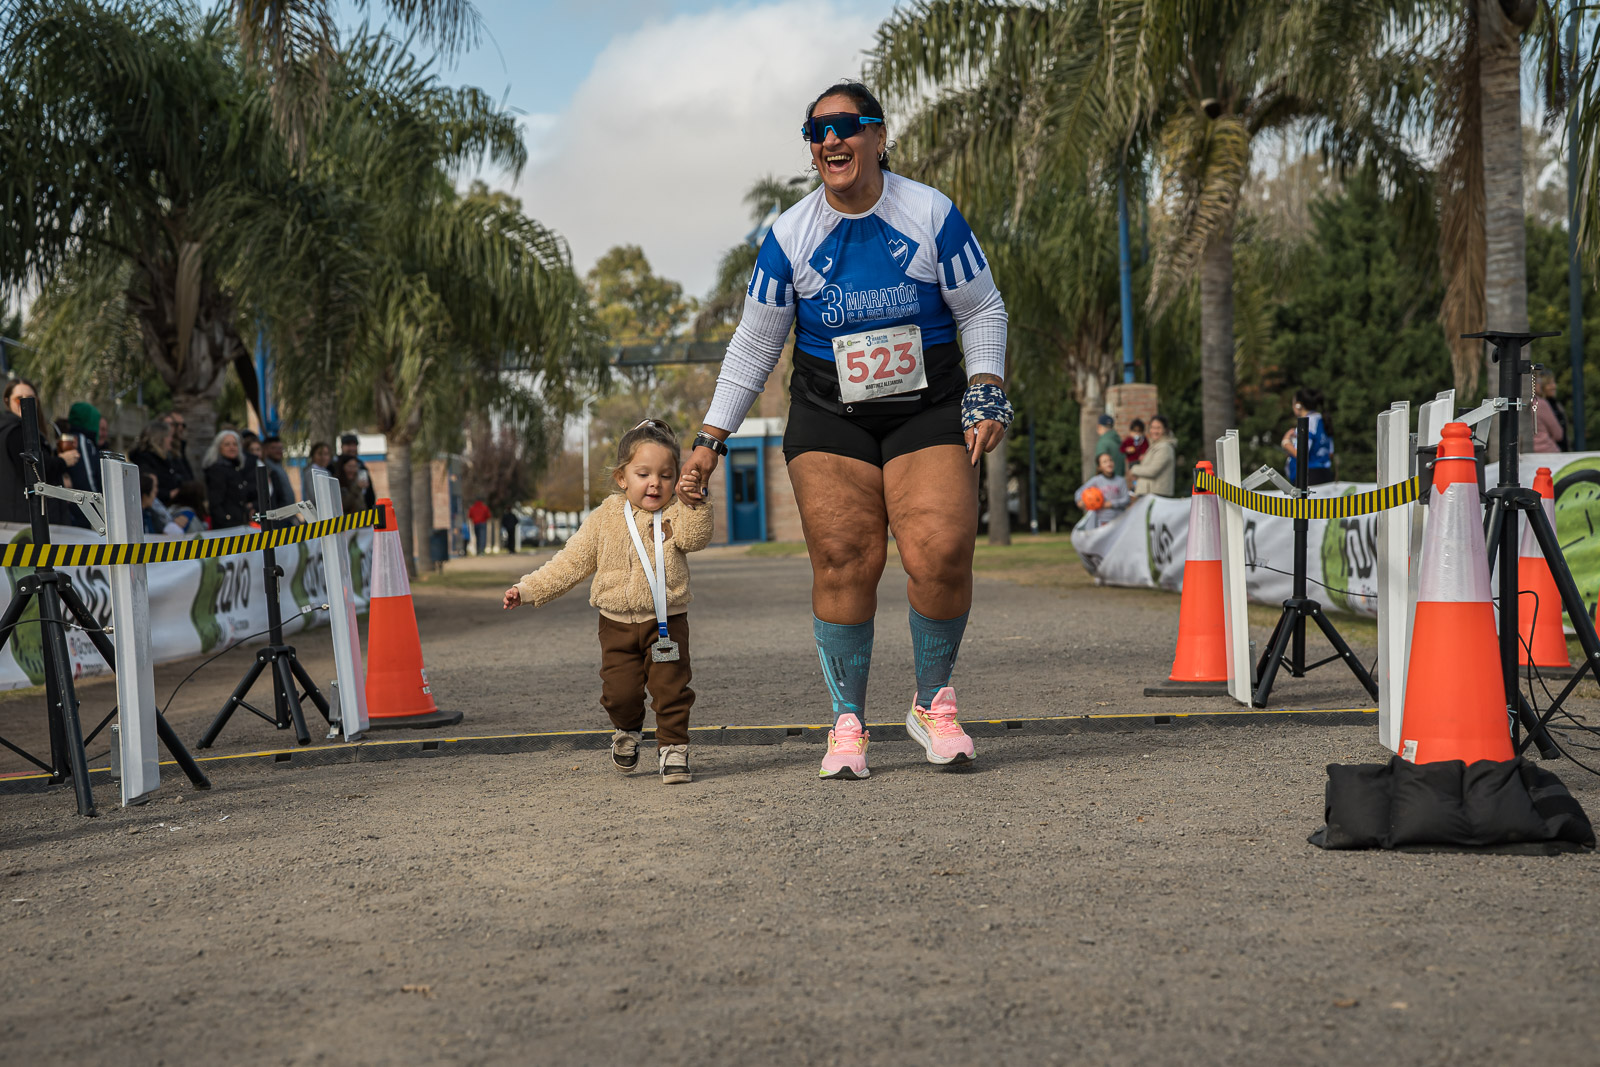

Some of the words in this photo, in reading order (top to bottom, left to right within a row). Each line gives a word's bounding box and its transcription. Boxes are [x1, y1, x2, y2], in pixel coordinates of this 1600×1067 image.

[821, 284, 845, 328] 3
[845, 282, 918, 311] MARATÓN
[865, 335, 872, 346] 3
[847, 341, 917, 384] 523
